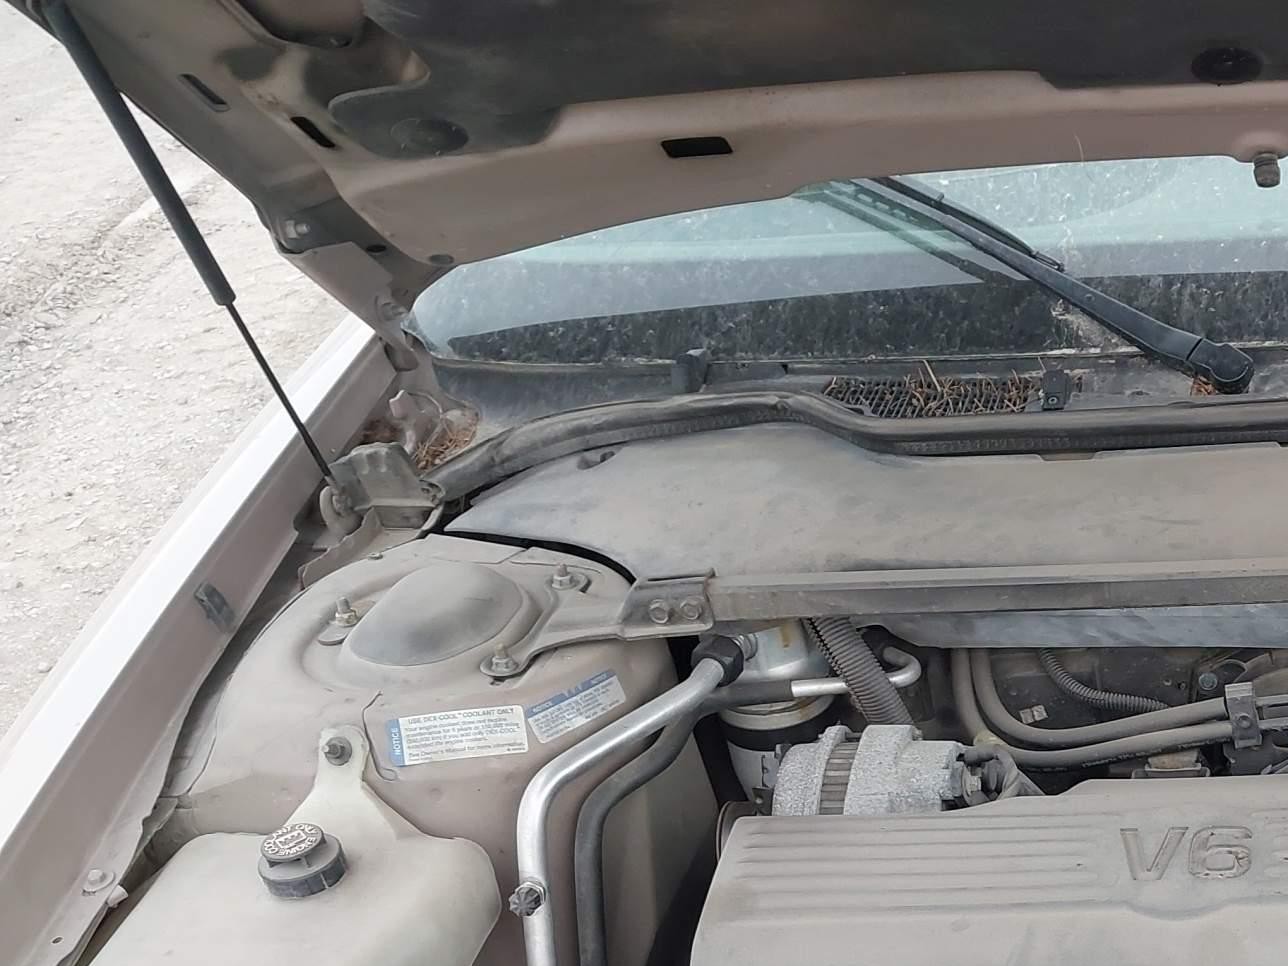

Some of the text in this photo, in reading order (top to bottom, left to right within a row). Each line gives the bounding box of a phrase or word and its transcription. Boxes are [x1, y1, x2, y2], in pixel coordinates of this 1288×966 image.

[462, 709, 496, 718] COOLANT
[391, 727, 400, 756] NOTICE
[1120, 826, 1252, 881] V6
